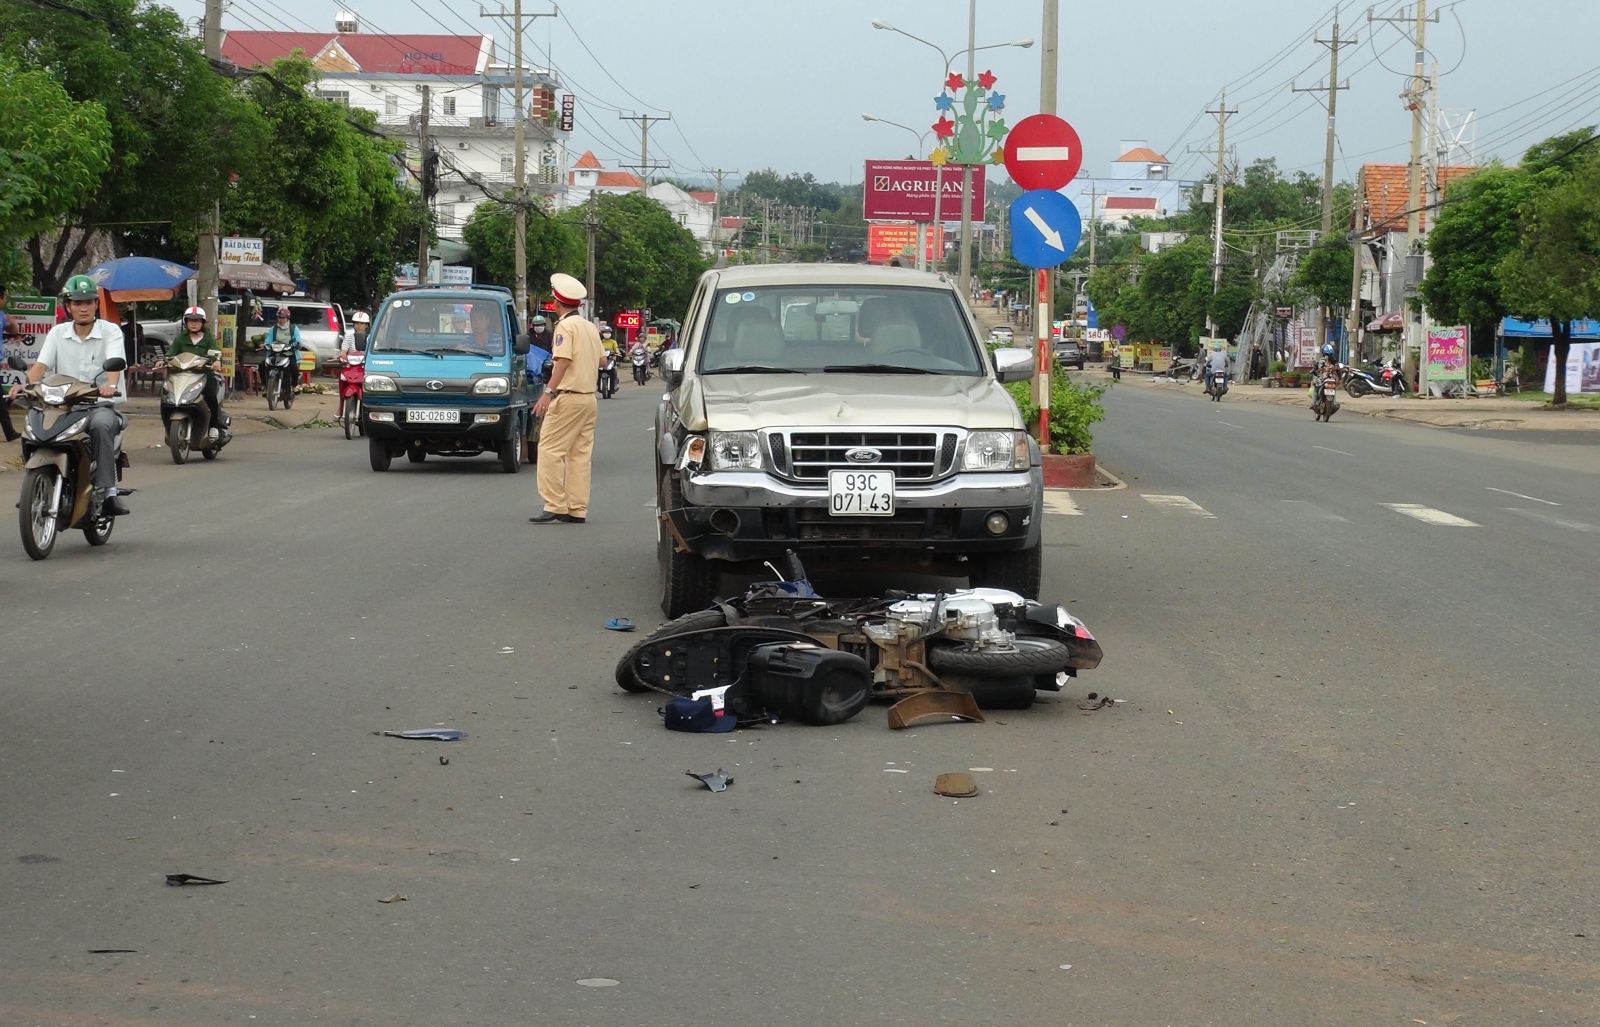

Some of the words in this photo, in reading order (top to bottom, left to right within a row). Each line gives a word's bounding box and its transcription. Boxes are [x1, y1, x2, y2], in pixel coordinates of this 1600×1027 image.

[563, 96, 574, 130] HOTEL
[16, 302, 47, 310] Castrol
[1430, 329, 1464, 340] Coffee
[1431, 346, 1445, 355] Trà
[854, 452, 873, 460] Ford
[846, 474, 877, 491] 93C
[833, 493, 891, 511] 071.43
